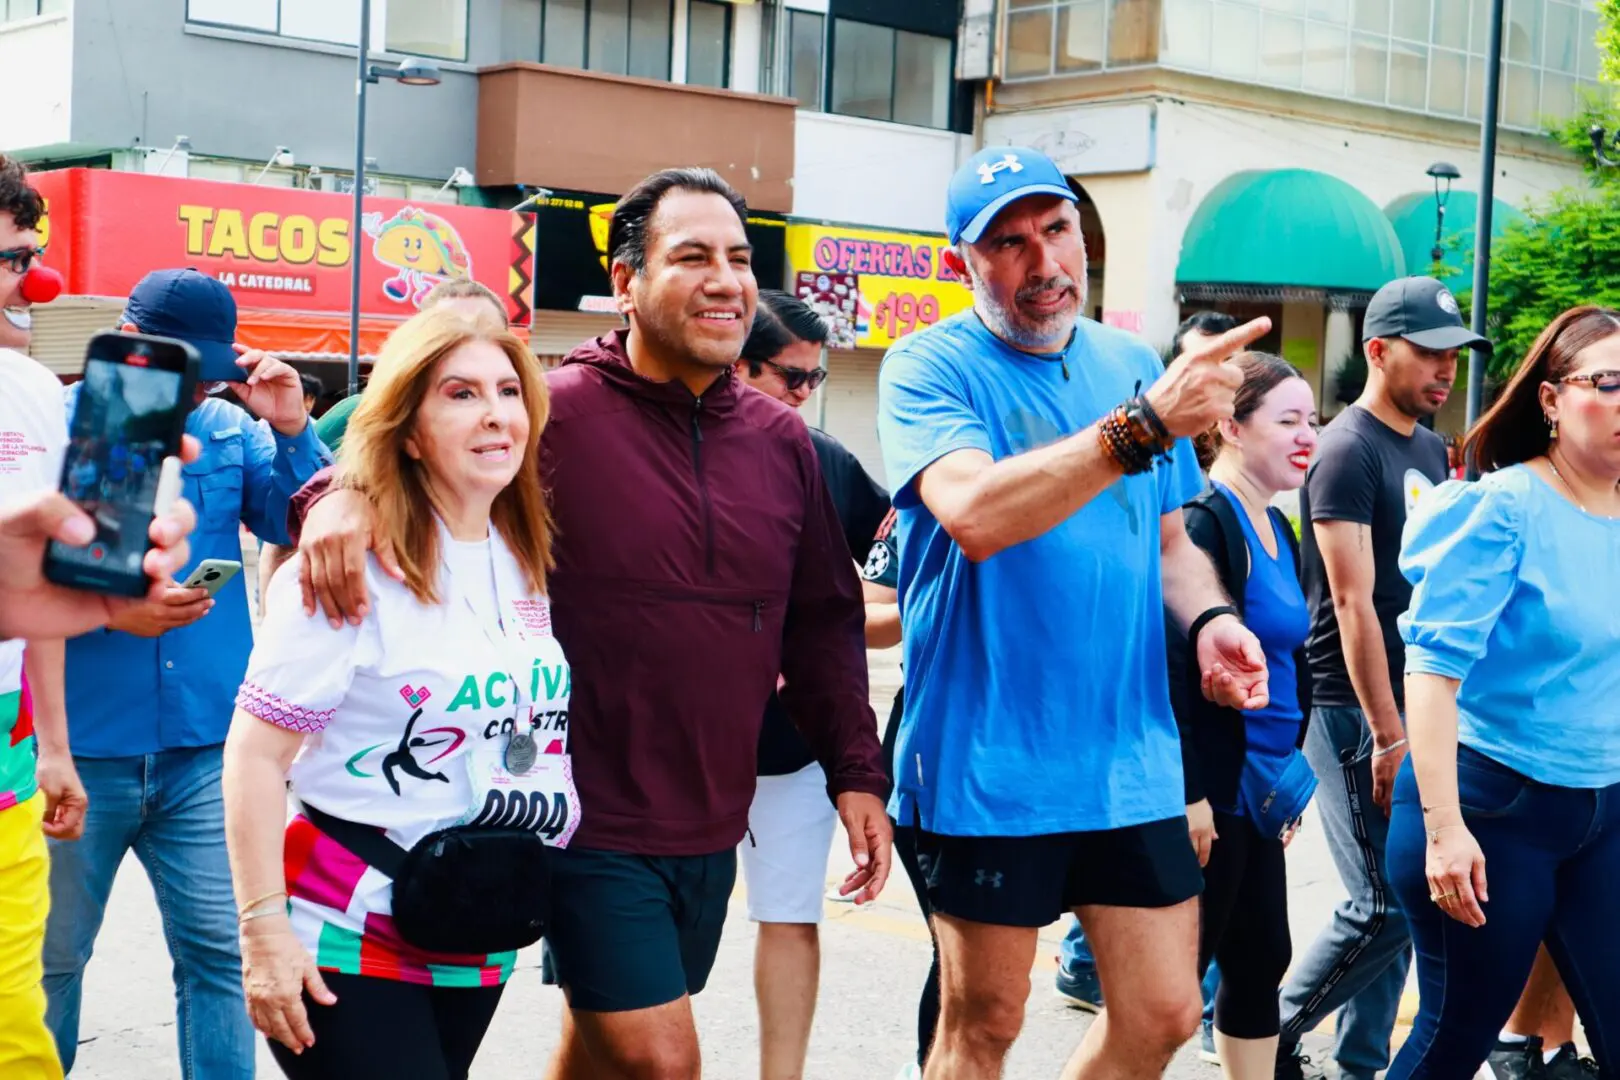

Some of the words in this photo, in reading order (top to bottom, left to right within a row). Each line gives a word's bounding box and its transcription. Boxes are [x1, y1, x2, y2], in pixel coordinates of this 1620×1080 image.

[178, 205, 352, 267] TACOS
[814, 236, 933, 279] OFERTAS
[219, 272, 237, 288] LA
[238, 273, 312, 293] CATEDRAL
[875, 291, 940, 339] $199
[483, 710, 569, 740] COSTR
[468, 788, 569, 840] 0004
